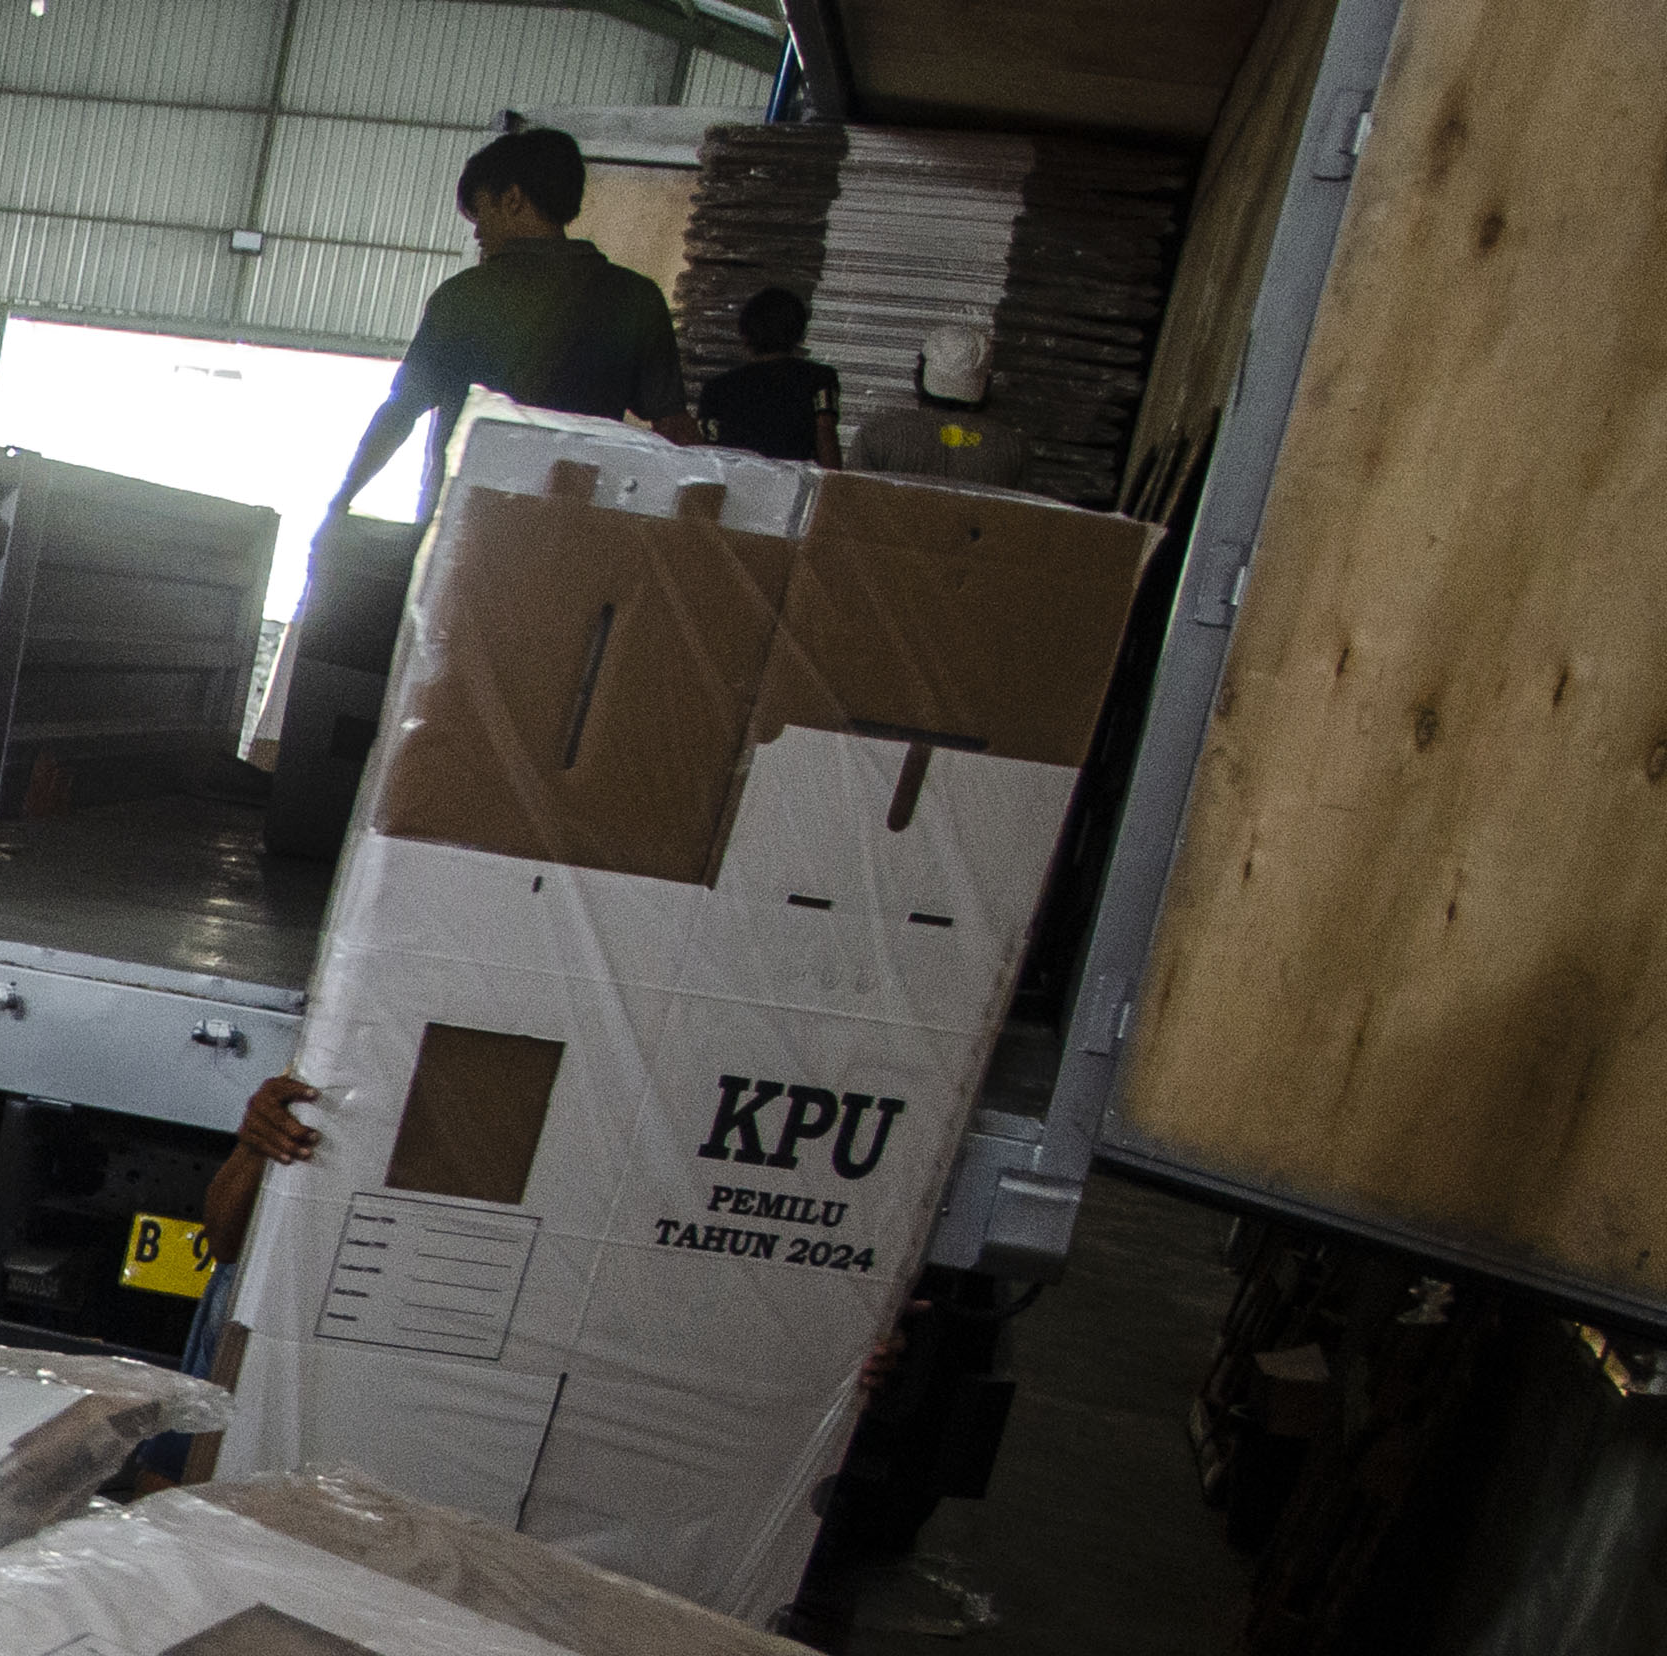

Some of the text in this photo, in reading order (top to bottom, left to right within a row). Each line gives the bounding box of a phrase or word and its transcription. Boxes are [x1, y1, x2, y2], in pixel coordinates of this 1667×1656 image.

[697, 1074, 906, 1181] KPU
[707, 1185, 849, 1228] PEMILU
[135, 1219, 163, 1263] B
[655, 1218, 874, 1273] TAHUN 2024
